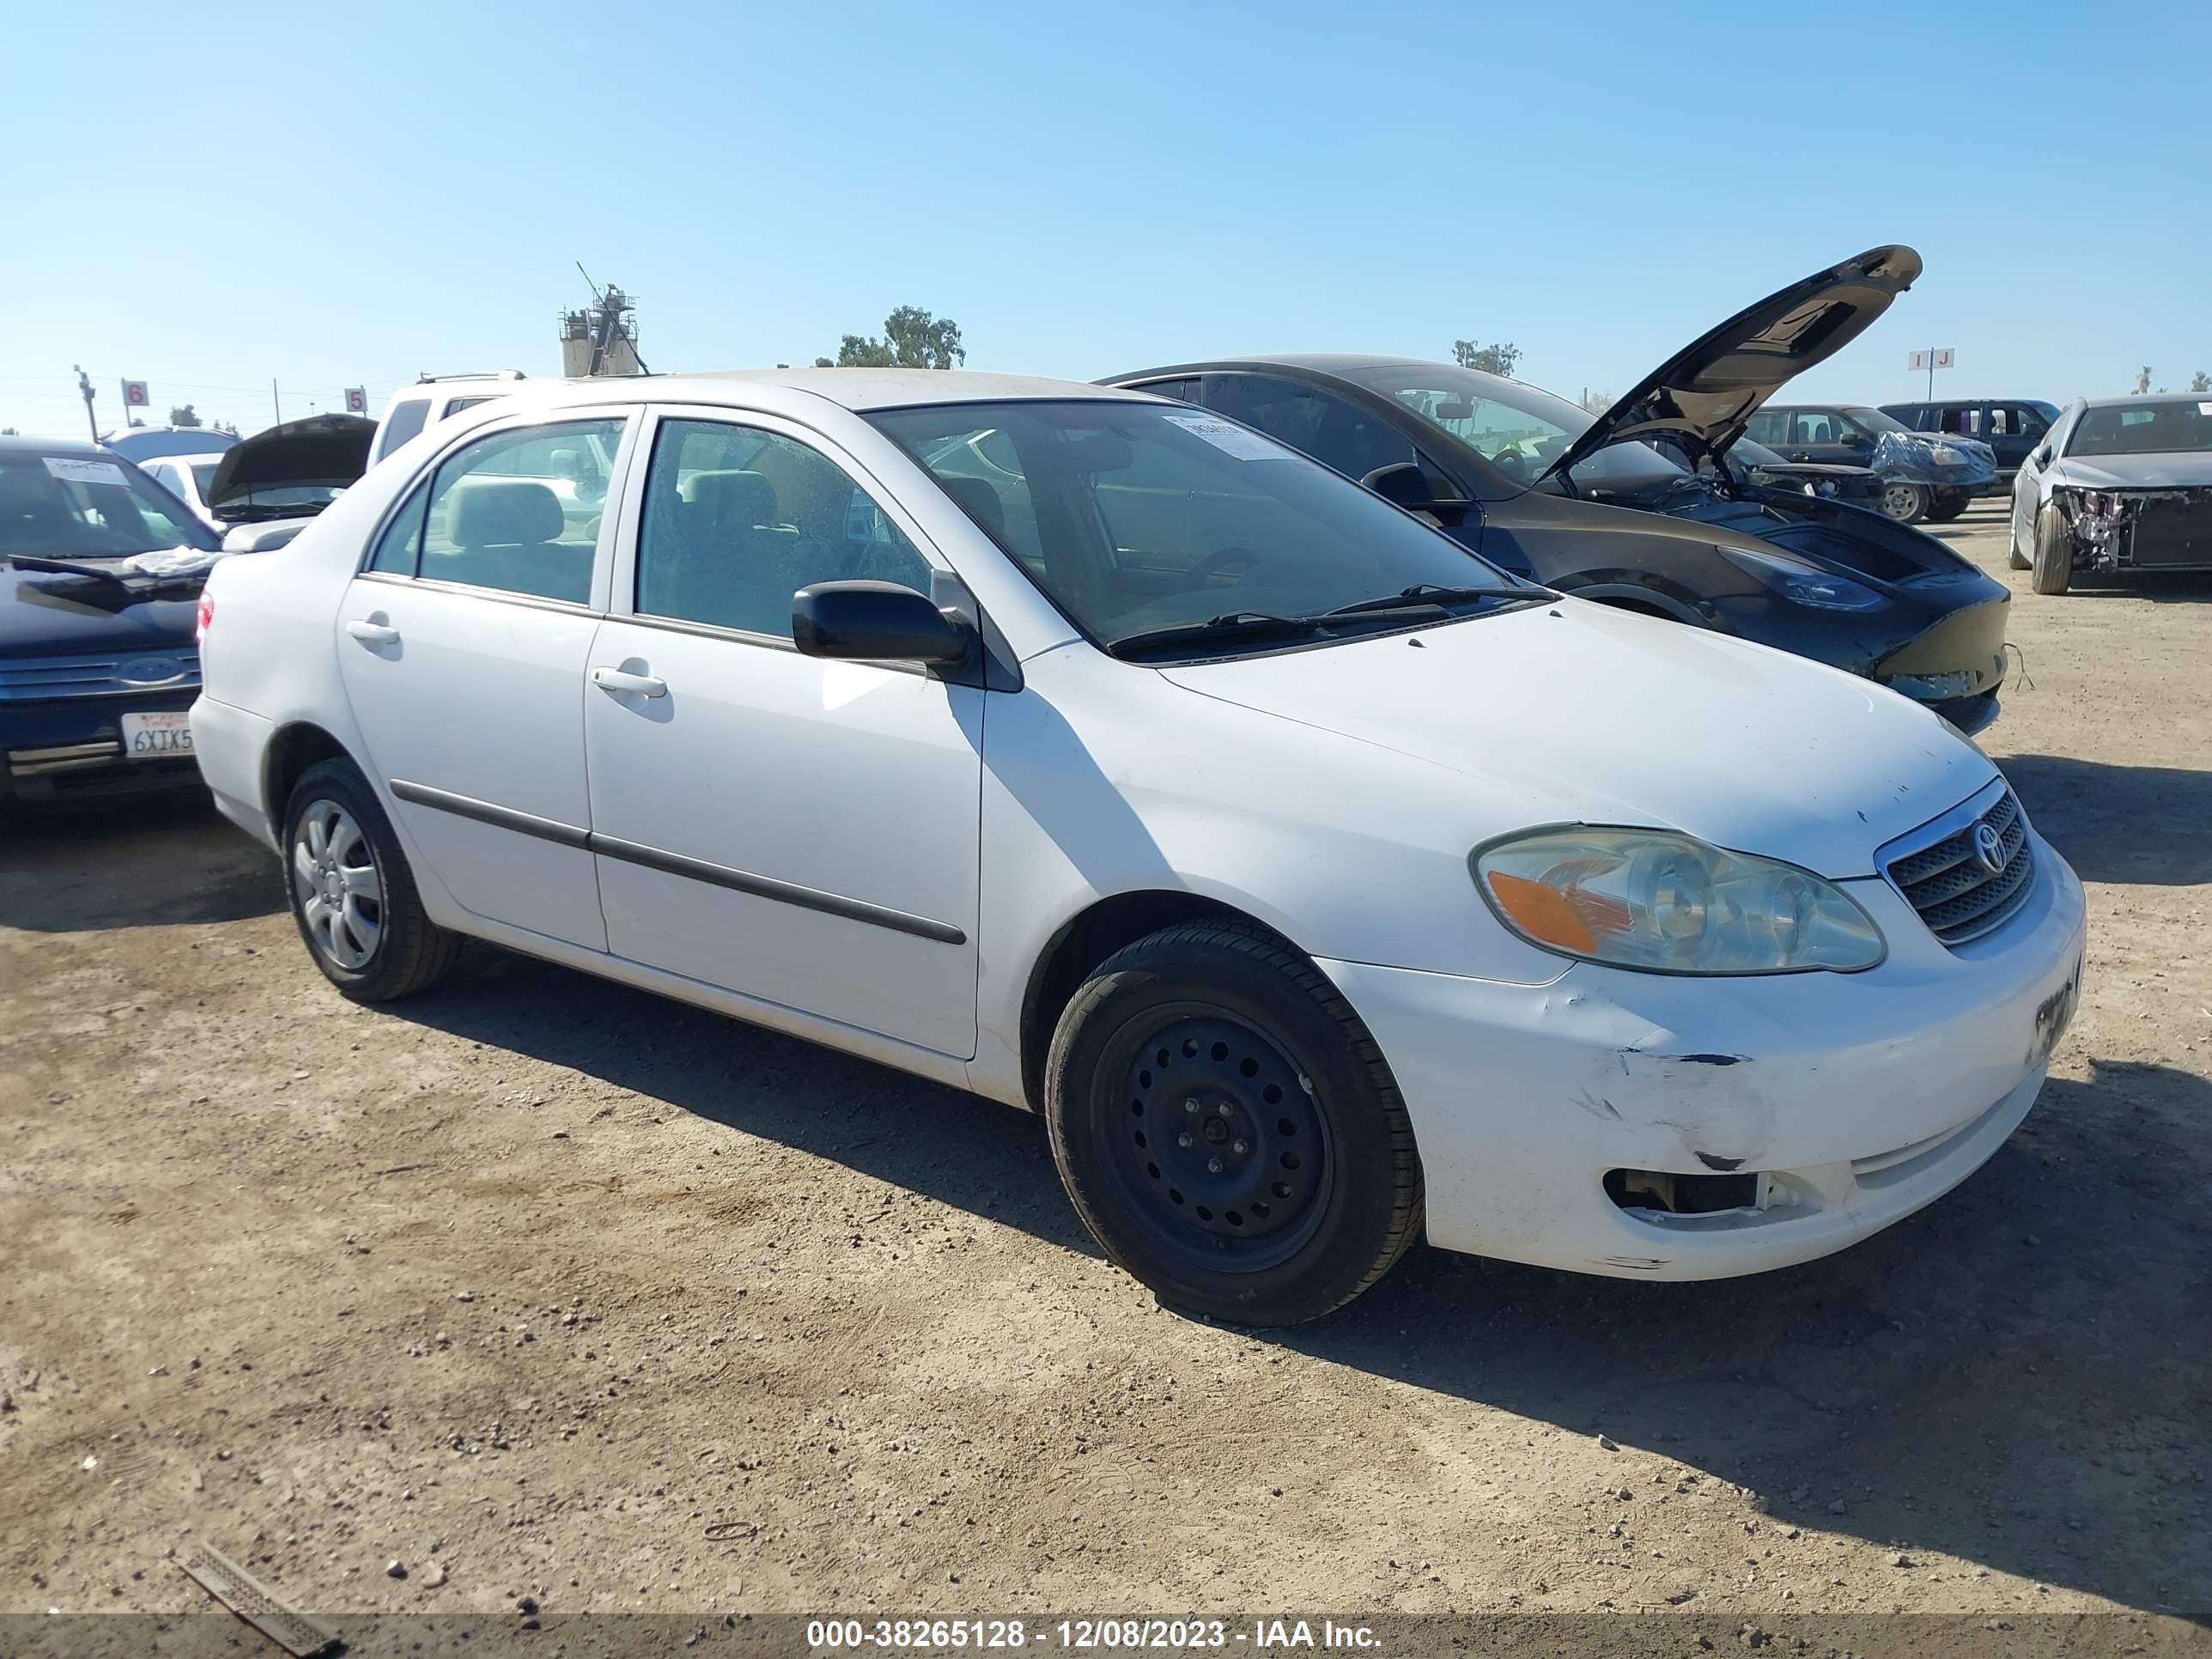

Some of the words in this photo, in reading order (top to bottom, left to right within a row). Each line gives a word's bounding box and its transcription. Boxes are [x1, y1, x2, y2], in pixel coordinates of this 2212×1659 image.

[1939, 351, 1948, 365] J
[128, 384, 143, 404] 6
[349, 391, 363, 410] 5
